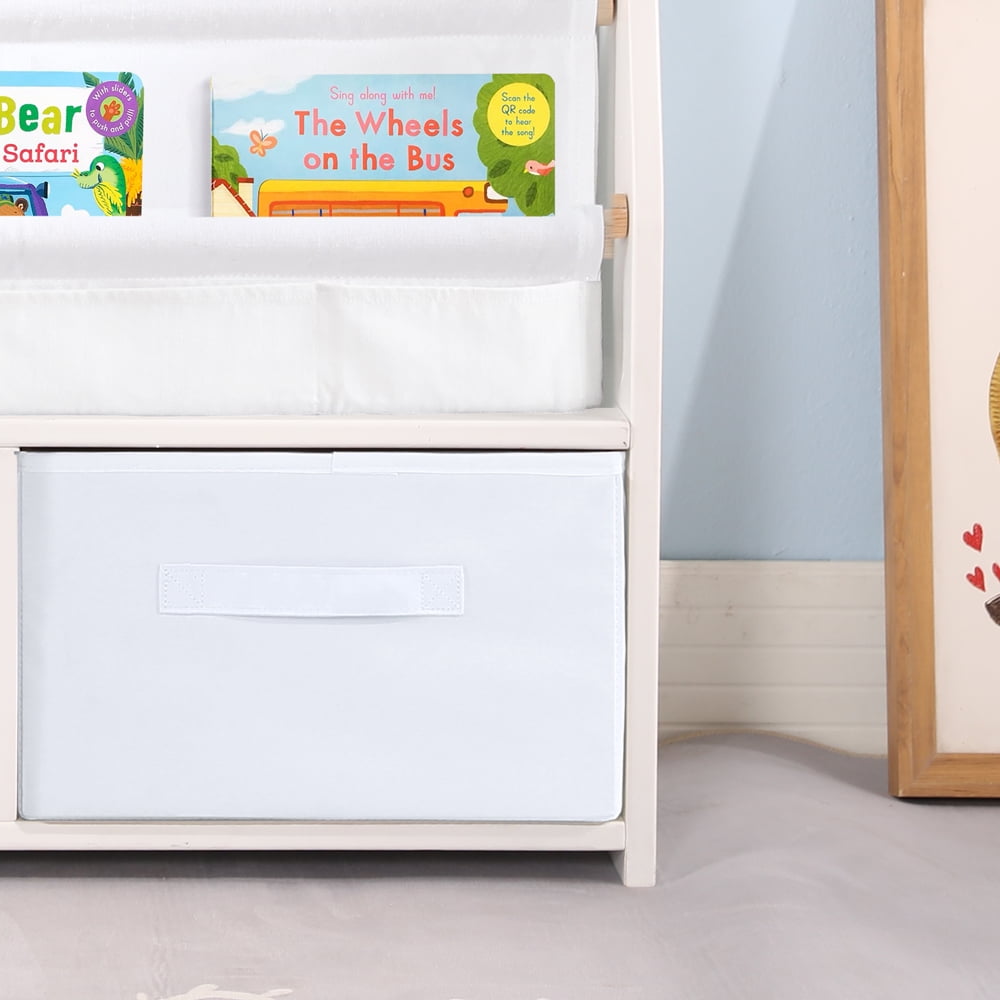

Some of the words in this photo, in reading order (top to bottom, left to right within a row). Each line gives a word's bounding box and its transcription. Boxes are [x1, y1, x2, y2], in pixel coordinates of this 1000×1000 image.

[92, 86, 109, 101] With
[111, 84, 132, 102] sliders
[329, 85, 354, 106] Sing
[360, 86, 387, 106] along
[392, 86, 415, 100] with
[419, 86, 436, 100] me!
[501, 92, 521, 102] Scan
[523, 92, 536, 101] the
[90, 109, 96, 118] to
[501, 104, 517, 116] QR
[518, 105, 536, 114] code
[92, 118, 109, 132] push
[110, 122, 124, 133] and
[294, 108, 347, 137] The
[355, 108, 464, 137] Wheels
[516, 116, 532, 125] hear
[501, 126, 514, 136] the
[517, 126, 536, 140] song!
[3, 142, 79, 164] Safari
[303, 152, 338, 170] on
[349, 143, 395, 171] the
[407, 144, 455, 171] Bus
